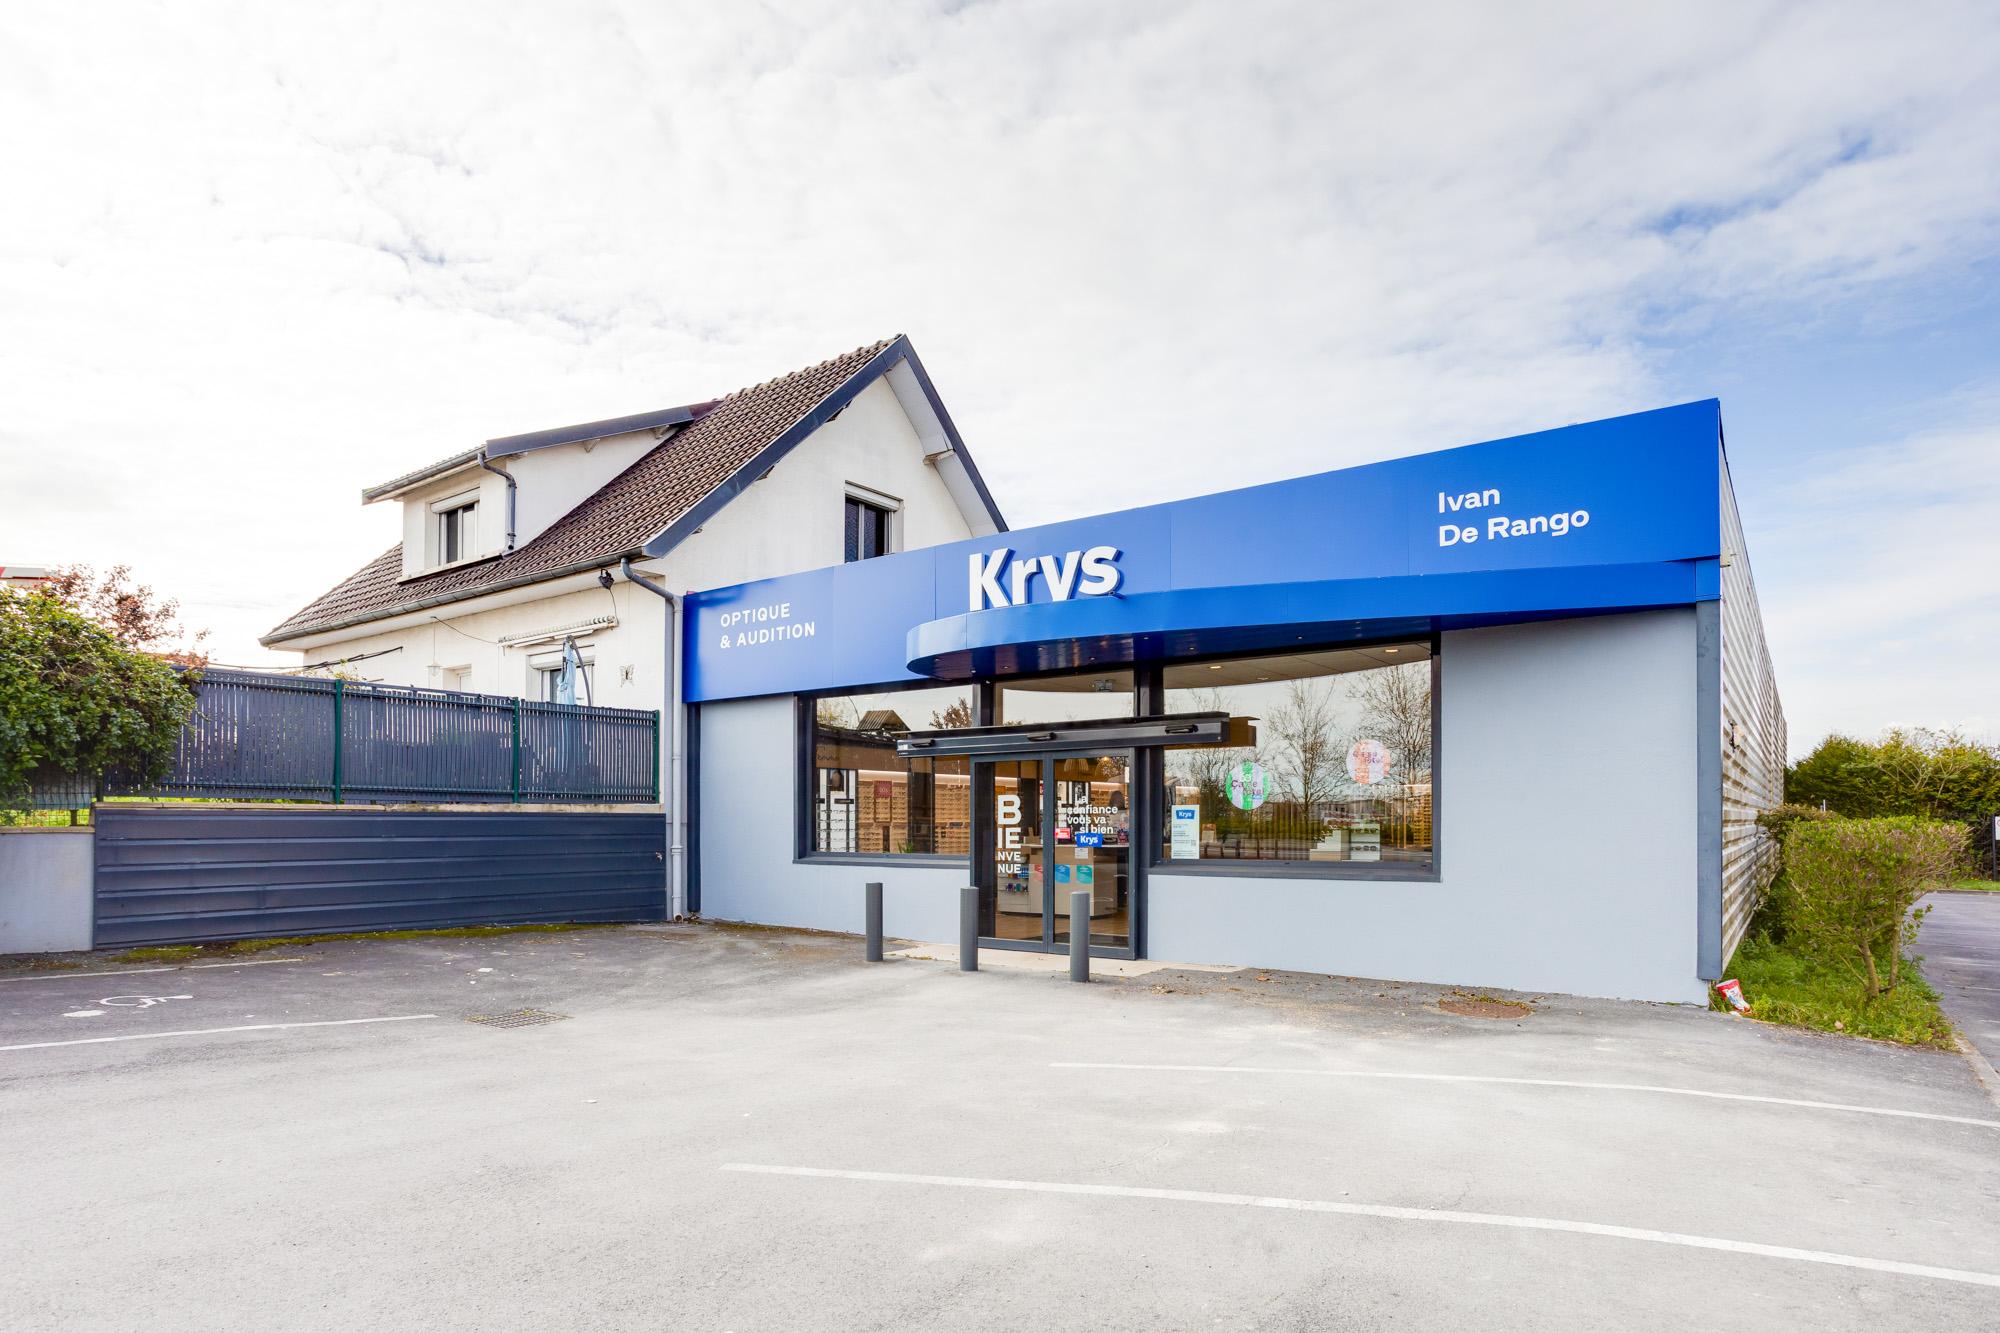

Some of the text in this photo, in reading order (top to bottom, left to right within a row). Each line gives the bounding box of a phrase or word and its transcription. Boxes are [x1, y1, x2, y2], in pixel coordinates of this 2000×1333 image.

[1438, 488, 1500, 514] Ivan
[1439, 509, 1590, 547] De Rango
[969, 546, 1120, 612] Krys
[720, 603, 791, 627] OPTIQUE
[720, 621, 815, 648] & AUDITION
[998, 795, 1022, 824] B
[1067, 805, 1118, 814] confiance
[1067, 816, 1107, 824] vous va
[1090, 824, 1114, 834] bien
[998, 828, 1021, 848] IE
[1080, 835, 1099, 845] Krys
[997, 852, 1021, 861] NVE
[997, 864, 1021, 873] NUE
